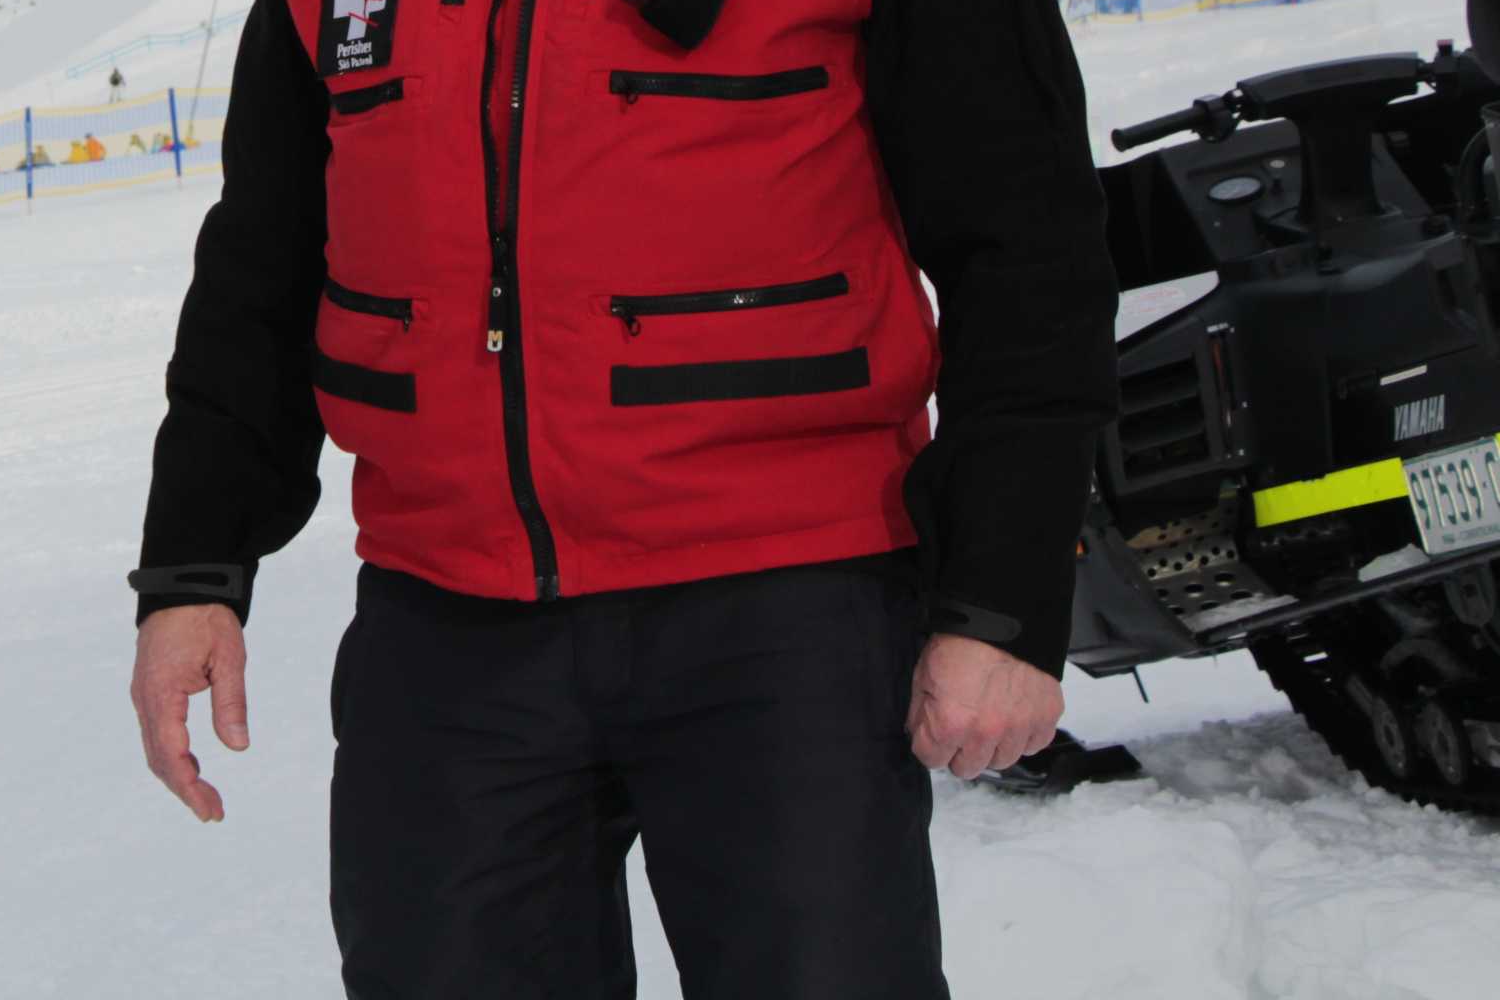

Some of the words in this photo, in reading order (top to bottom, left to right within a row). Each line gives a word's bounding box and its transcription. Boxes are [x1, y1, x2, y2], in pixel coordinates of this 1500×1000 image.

[336, 40, 372, 58] Perisher
[338, 59, 350, 71] Ski
[1394, 394, 1445, 441] YAMAHA
